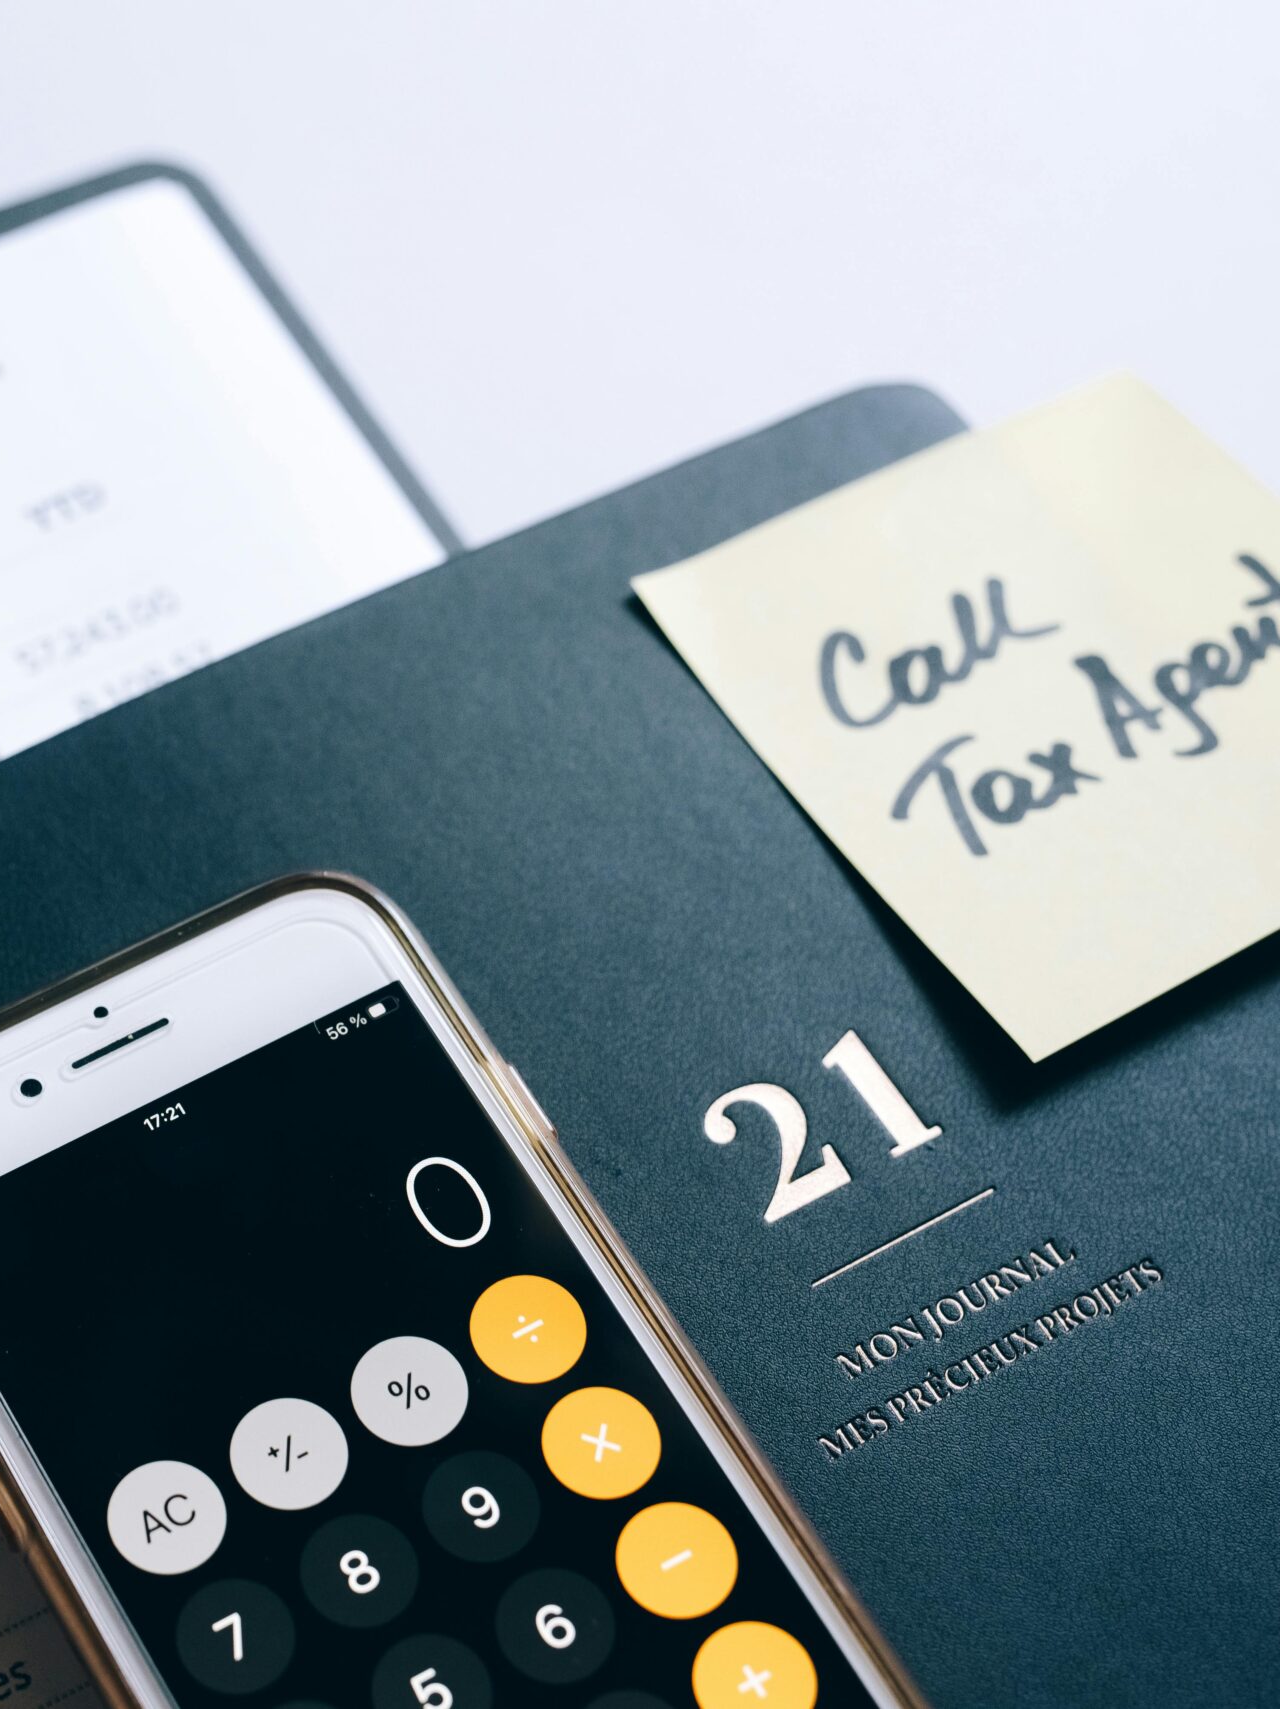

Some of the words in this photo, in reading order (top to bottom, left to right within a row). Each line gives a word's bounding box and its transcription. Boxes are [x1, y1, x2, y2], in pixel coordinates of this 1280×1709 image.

[818, 577, 1062, 729] Call
[889, 734, 1102, 858] Tax
[325, 1021, 349, 1040] 56
[143, 1102, 187, 1133] 17:21
[704, 1030, 943, 1223] 21
[406, 1157, 491, 1248] 0
[835, 1316, 925, 1379] MON
[921, 1239, 1077, 1343] JOURNAL
[818, 1410, 890, 1461] MES
[887, 1325, 1039, 1425] PRÉCIEUX
[1035, 1258, 1166, 1348] PROJETS
[140, 1493, 197, 1543] AC
[461, 1485, 501, 1529] 9
[339, 1549, 381, 1594] 8
[212, 1612, 243, 1661] 7
[535, 1604, 577, 1649] 6
[410, 1667, 453, 1709] 5
